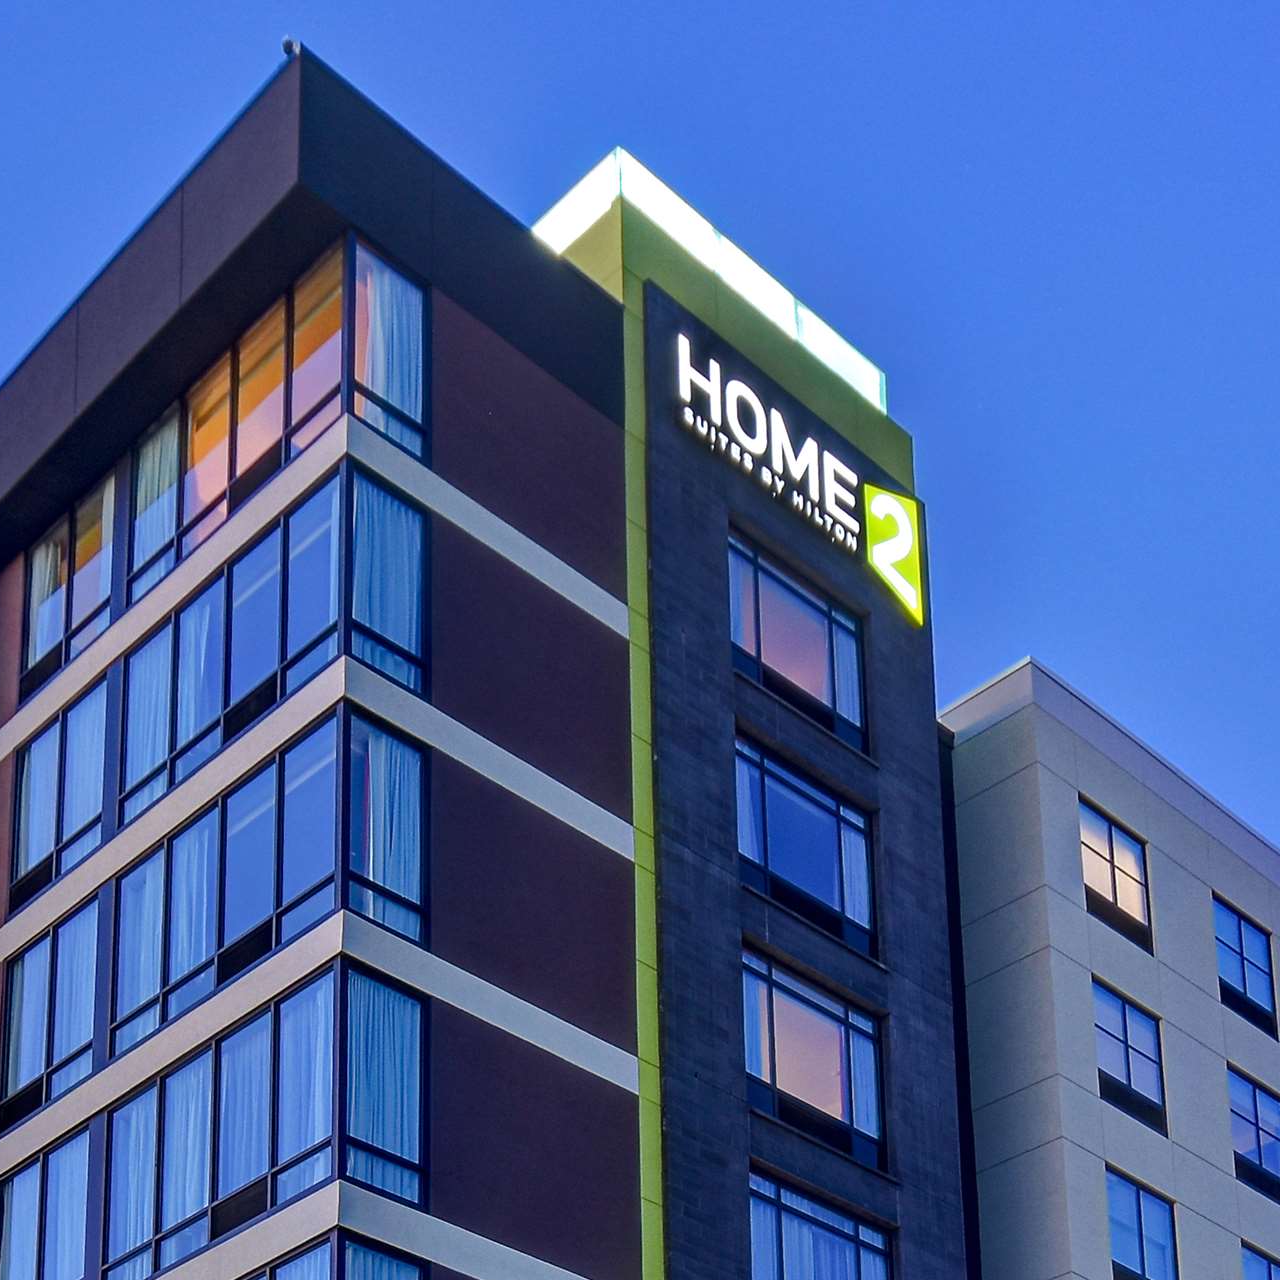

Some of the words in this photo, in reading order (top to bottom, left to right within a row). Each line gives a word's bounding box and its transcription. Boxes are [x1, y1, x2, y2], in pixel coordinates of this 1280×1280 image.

[677, 332, 860, 533] HOME
[870, 493, 919, 610] 2
[683, 406, 753, 471] SUITES
[761, 466, 785, 495] BY
[792, 491, 858, 552] HILTON
